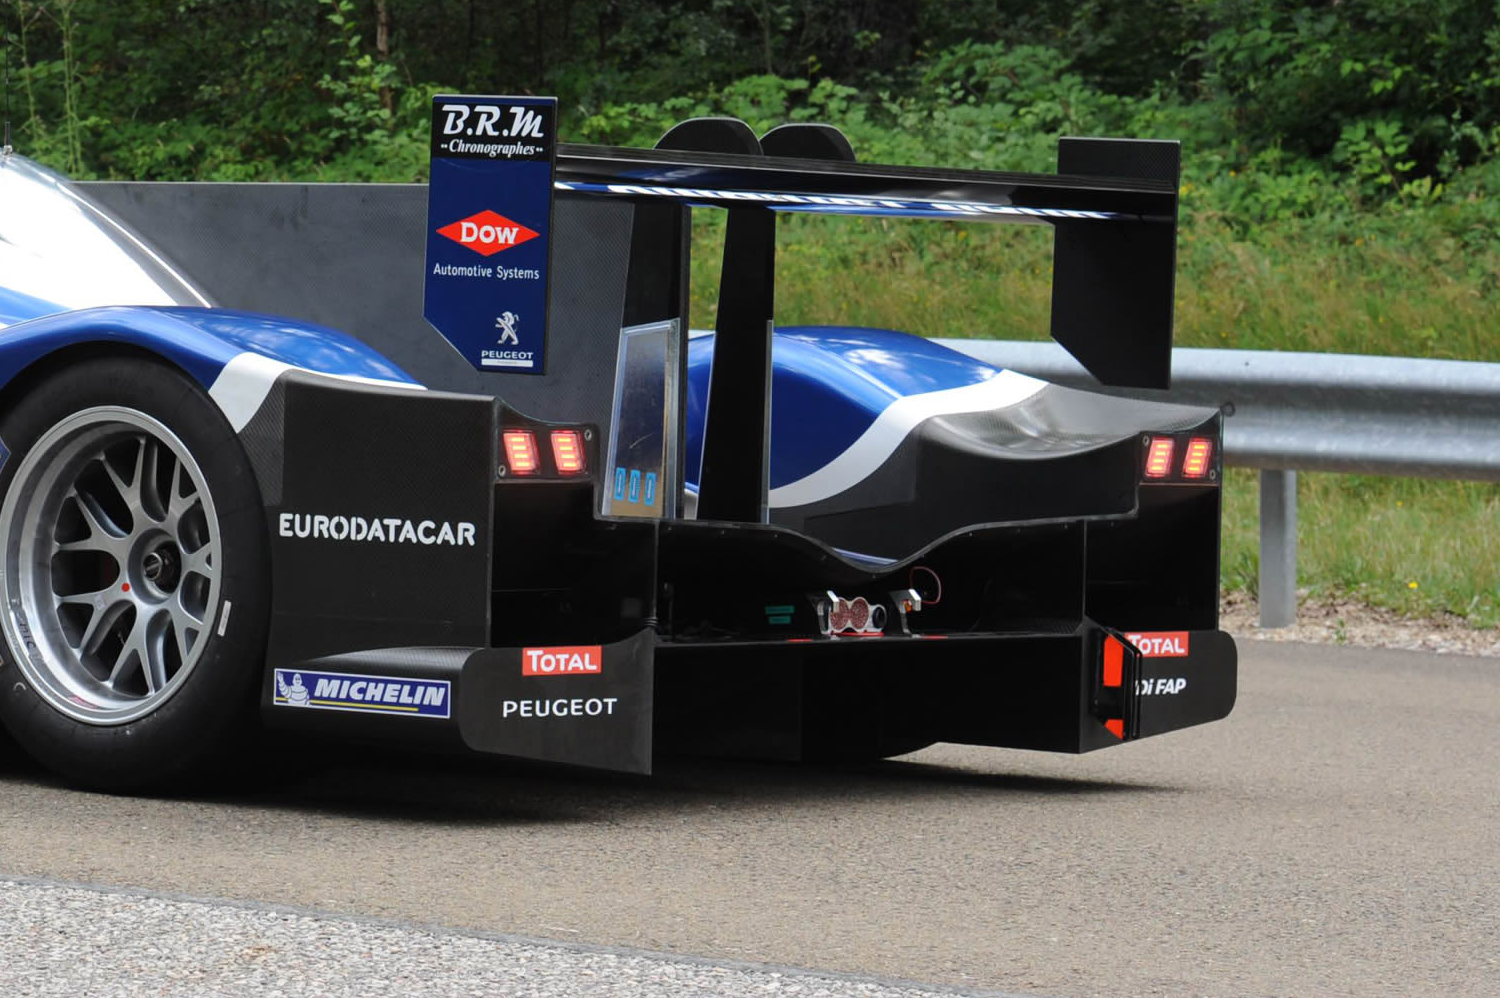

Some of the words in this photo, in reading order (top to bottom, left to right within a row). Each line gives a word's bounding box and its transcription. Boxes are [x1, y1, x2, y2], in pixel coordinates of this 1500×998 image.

[441, 104, 545, 138] B.R.M
[448, 139, 536, 158] Chronographes
[433, 262, 492, 278] Automotive
[496, 265, 540, 280] Systems
[481, 350, 534, 360] PEUGEOT
[279, 512, 476, 546] EURODATACAR
[314, 677, 446, 707] MICHELIN
[1155, 678, 1187, 695] FAP
[502, 697, 618, 718] PEUGEOT
